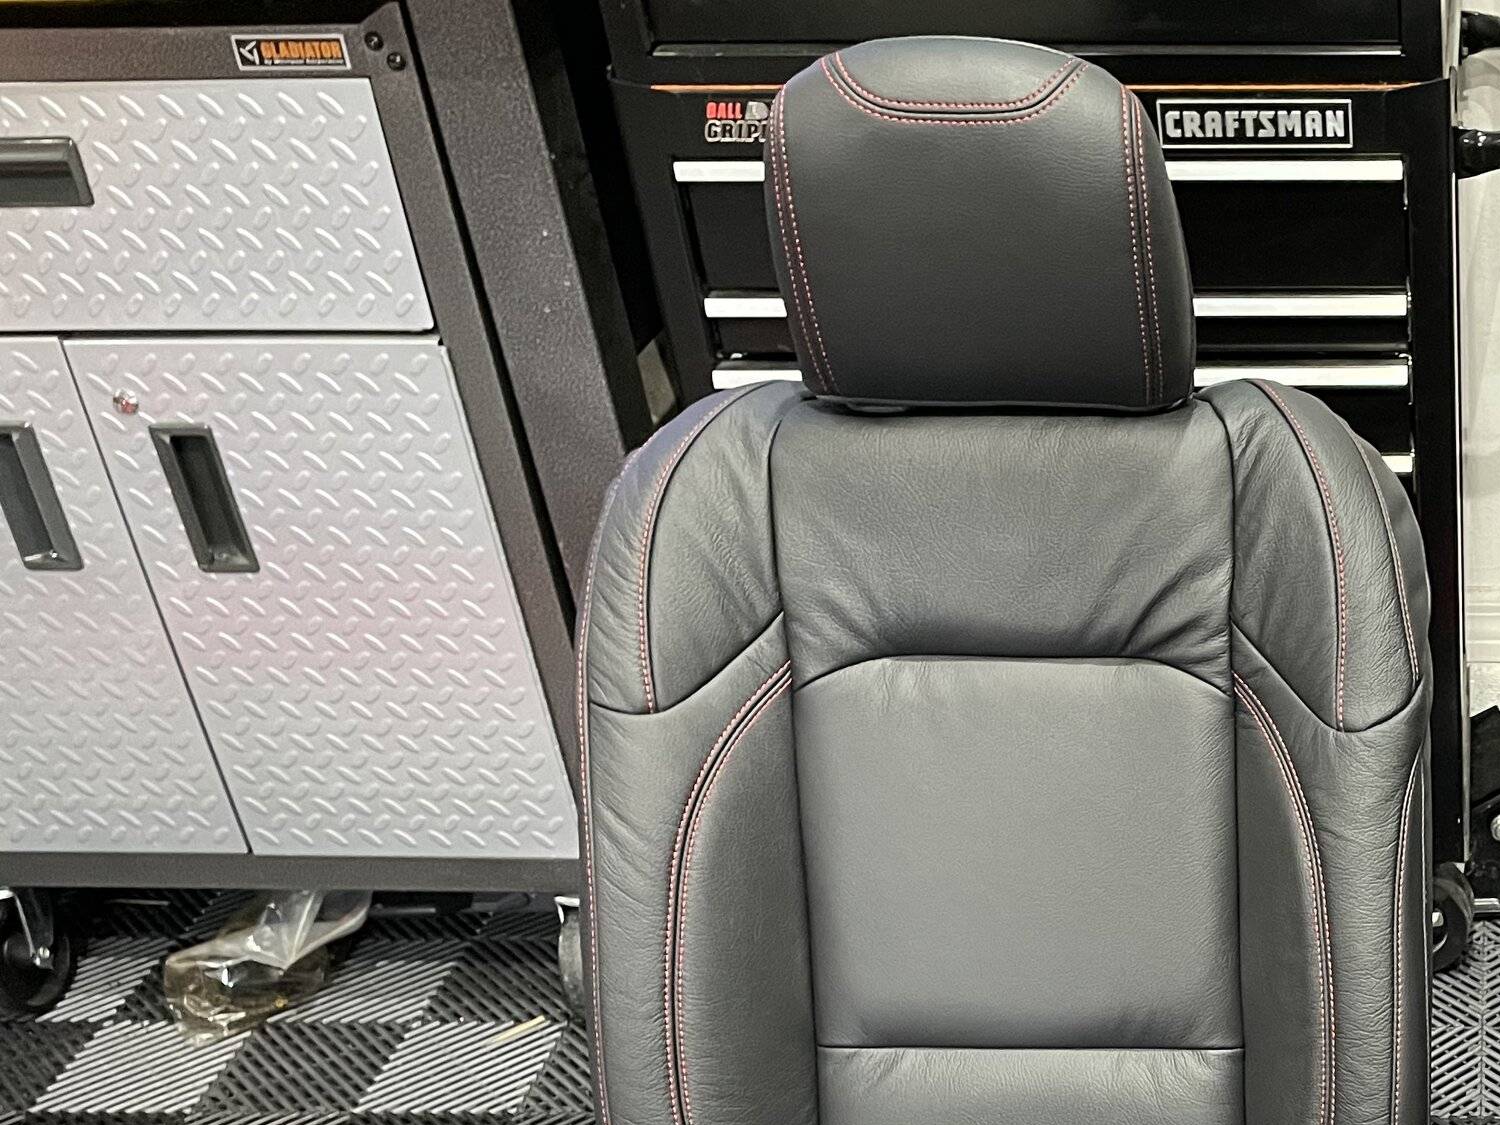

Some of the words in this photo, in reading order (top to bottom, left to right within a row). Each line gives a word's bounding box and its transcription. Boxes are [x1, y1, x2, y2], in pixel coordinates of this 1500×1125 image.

[261, 40, 342, 59] GLADIATOR
[706, 102, 742, 119] BALL
[1164, 110, 1345, 138] CRAFTSMAN
